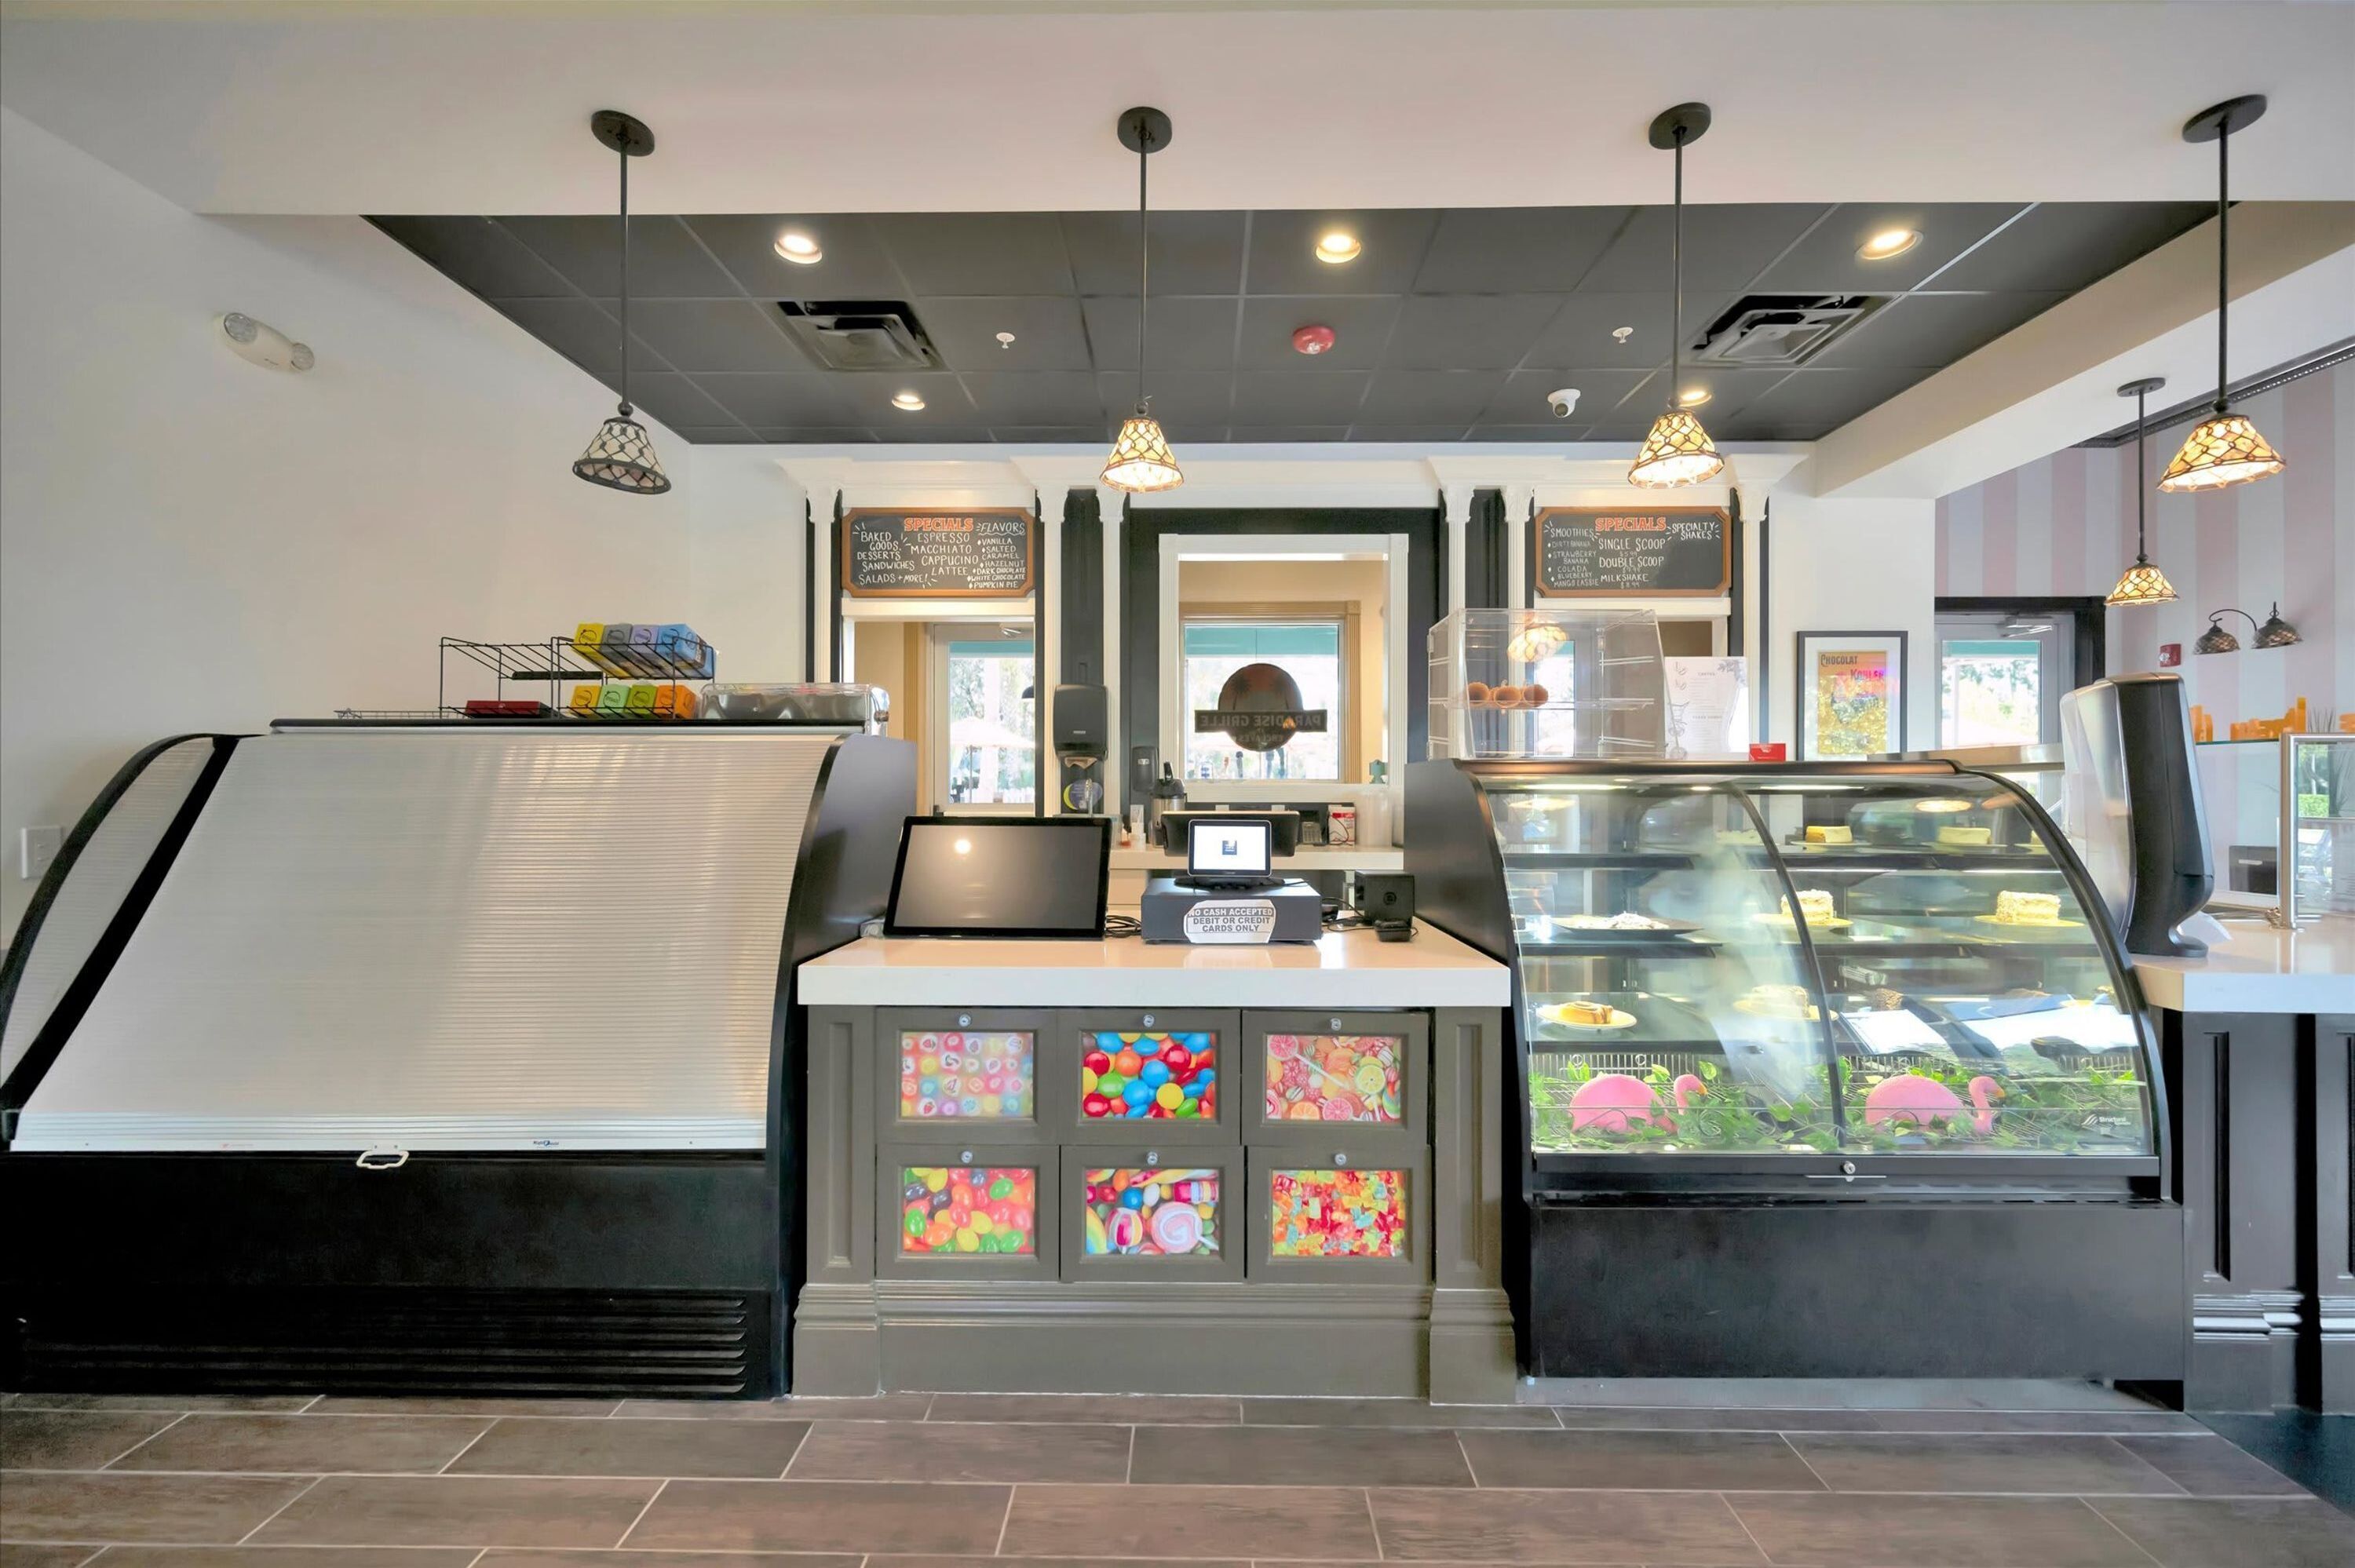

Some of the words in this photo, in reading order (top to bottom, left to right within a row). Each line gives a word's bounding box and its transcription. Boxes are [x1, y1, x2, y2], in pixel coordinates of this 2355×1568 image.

[904, 517, 973, 531] SPECIALS
[980, 522, 1025, 534] FLAVORS
[1595, 517, 1667, 531] SPECIALS
[1671, 522, 1716, 534] SPECIALTY
[861, 532, 892, 542] BAKED
[918, 533, 969, 543] ESPRESSO
[1550, 527, 1594, 538] SMOOTHIES
[1680, 531, 1713, 541] SHAKES
[911, 545, 972, 554] MACCHIATO
[1598, 538, 1631, 550] SINGLE
[1636, 538, 1666, 552] SCOOP
[857, 551, 900, 560] DESSERTS
[921, 555, 978, 566] CAPPUCINO
[862, 560, 915, 572] SANDWICHES
[1599, 556, 1634, 568] DOUBLE
[1638, 556, 1664, 567] SCOOP
[931, 567, 969, 576] LATTEE
[859, 574, 896, 585] SALADS
[1600, 574, 1649, 582] MILKSHAKE
